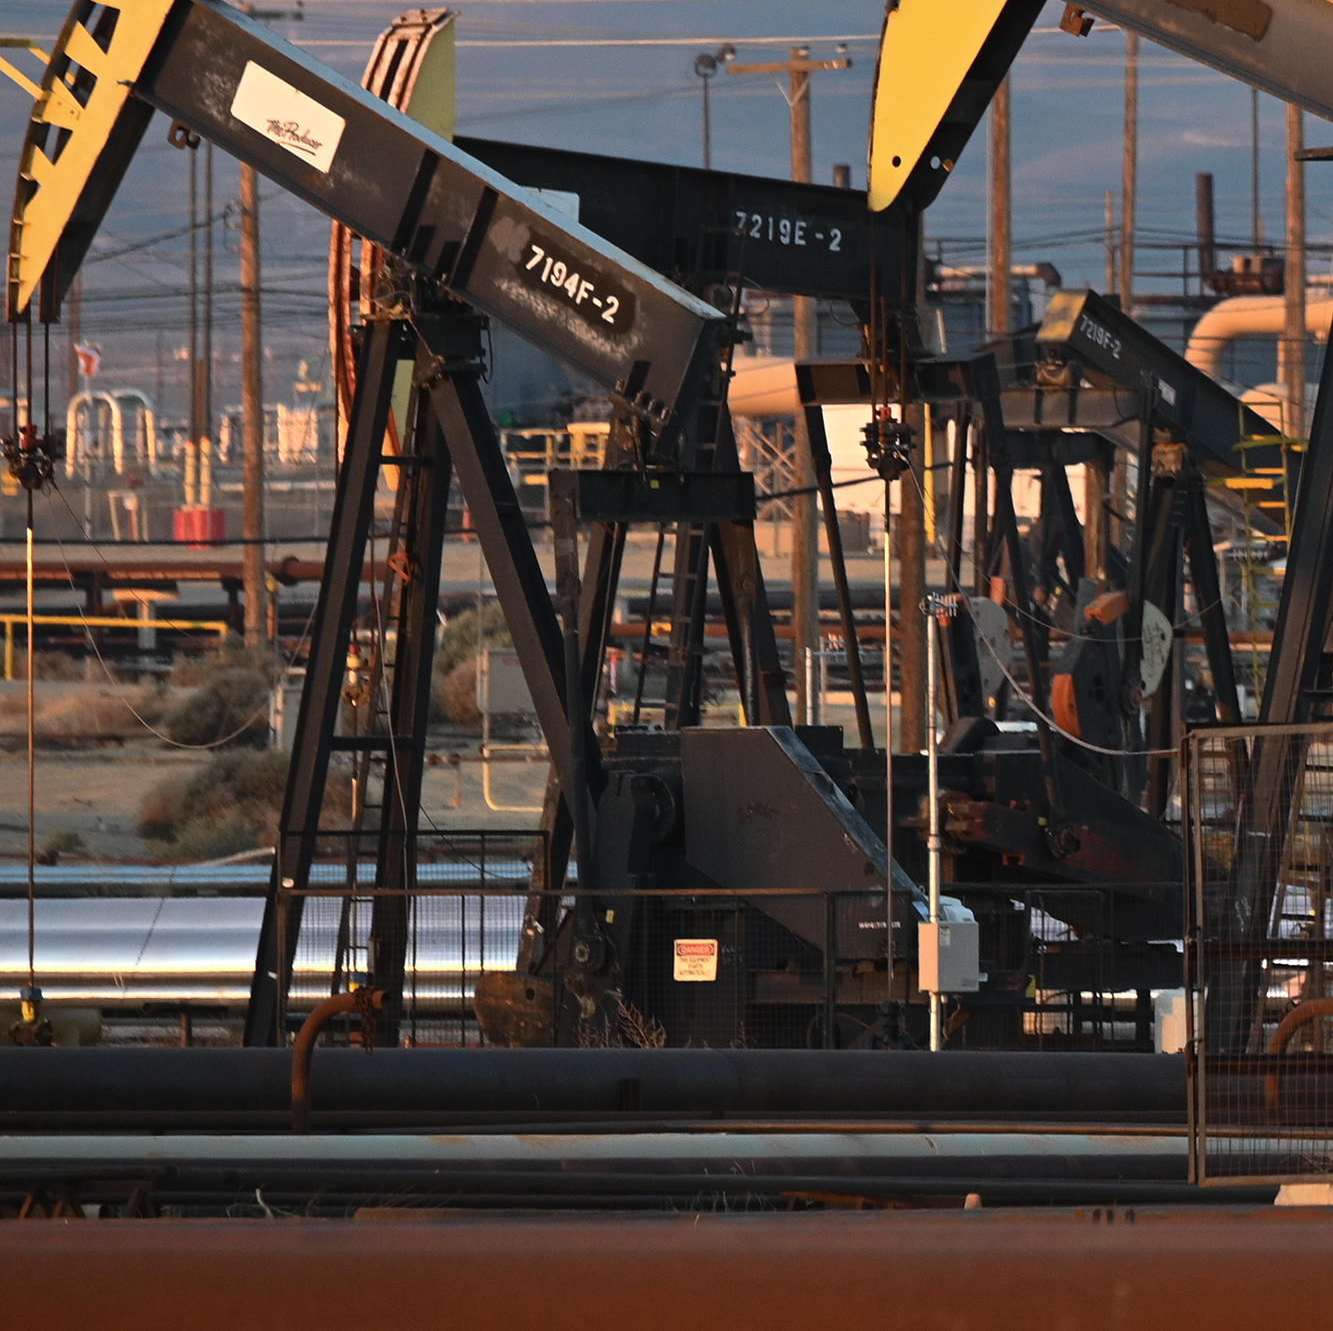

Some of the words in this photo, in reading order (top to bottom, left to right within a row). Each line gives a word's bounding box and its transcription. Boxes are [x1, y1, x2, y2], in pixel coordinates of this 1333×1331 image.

[736, 211, 842, 251] 7219E-2
[525, 244, 619, 324] 7194F-2
[1080, 315, 1121, 359] 7219F-2
